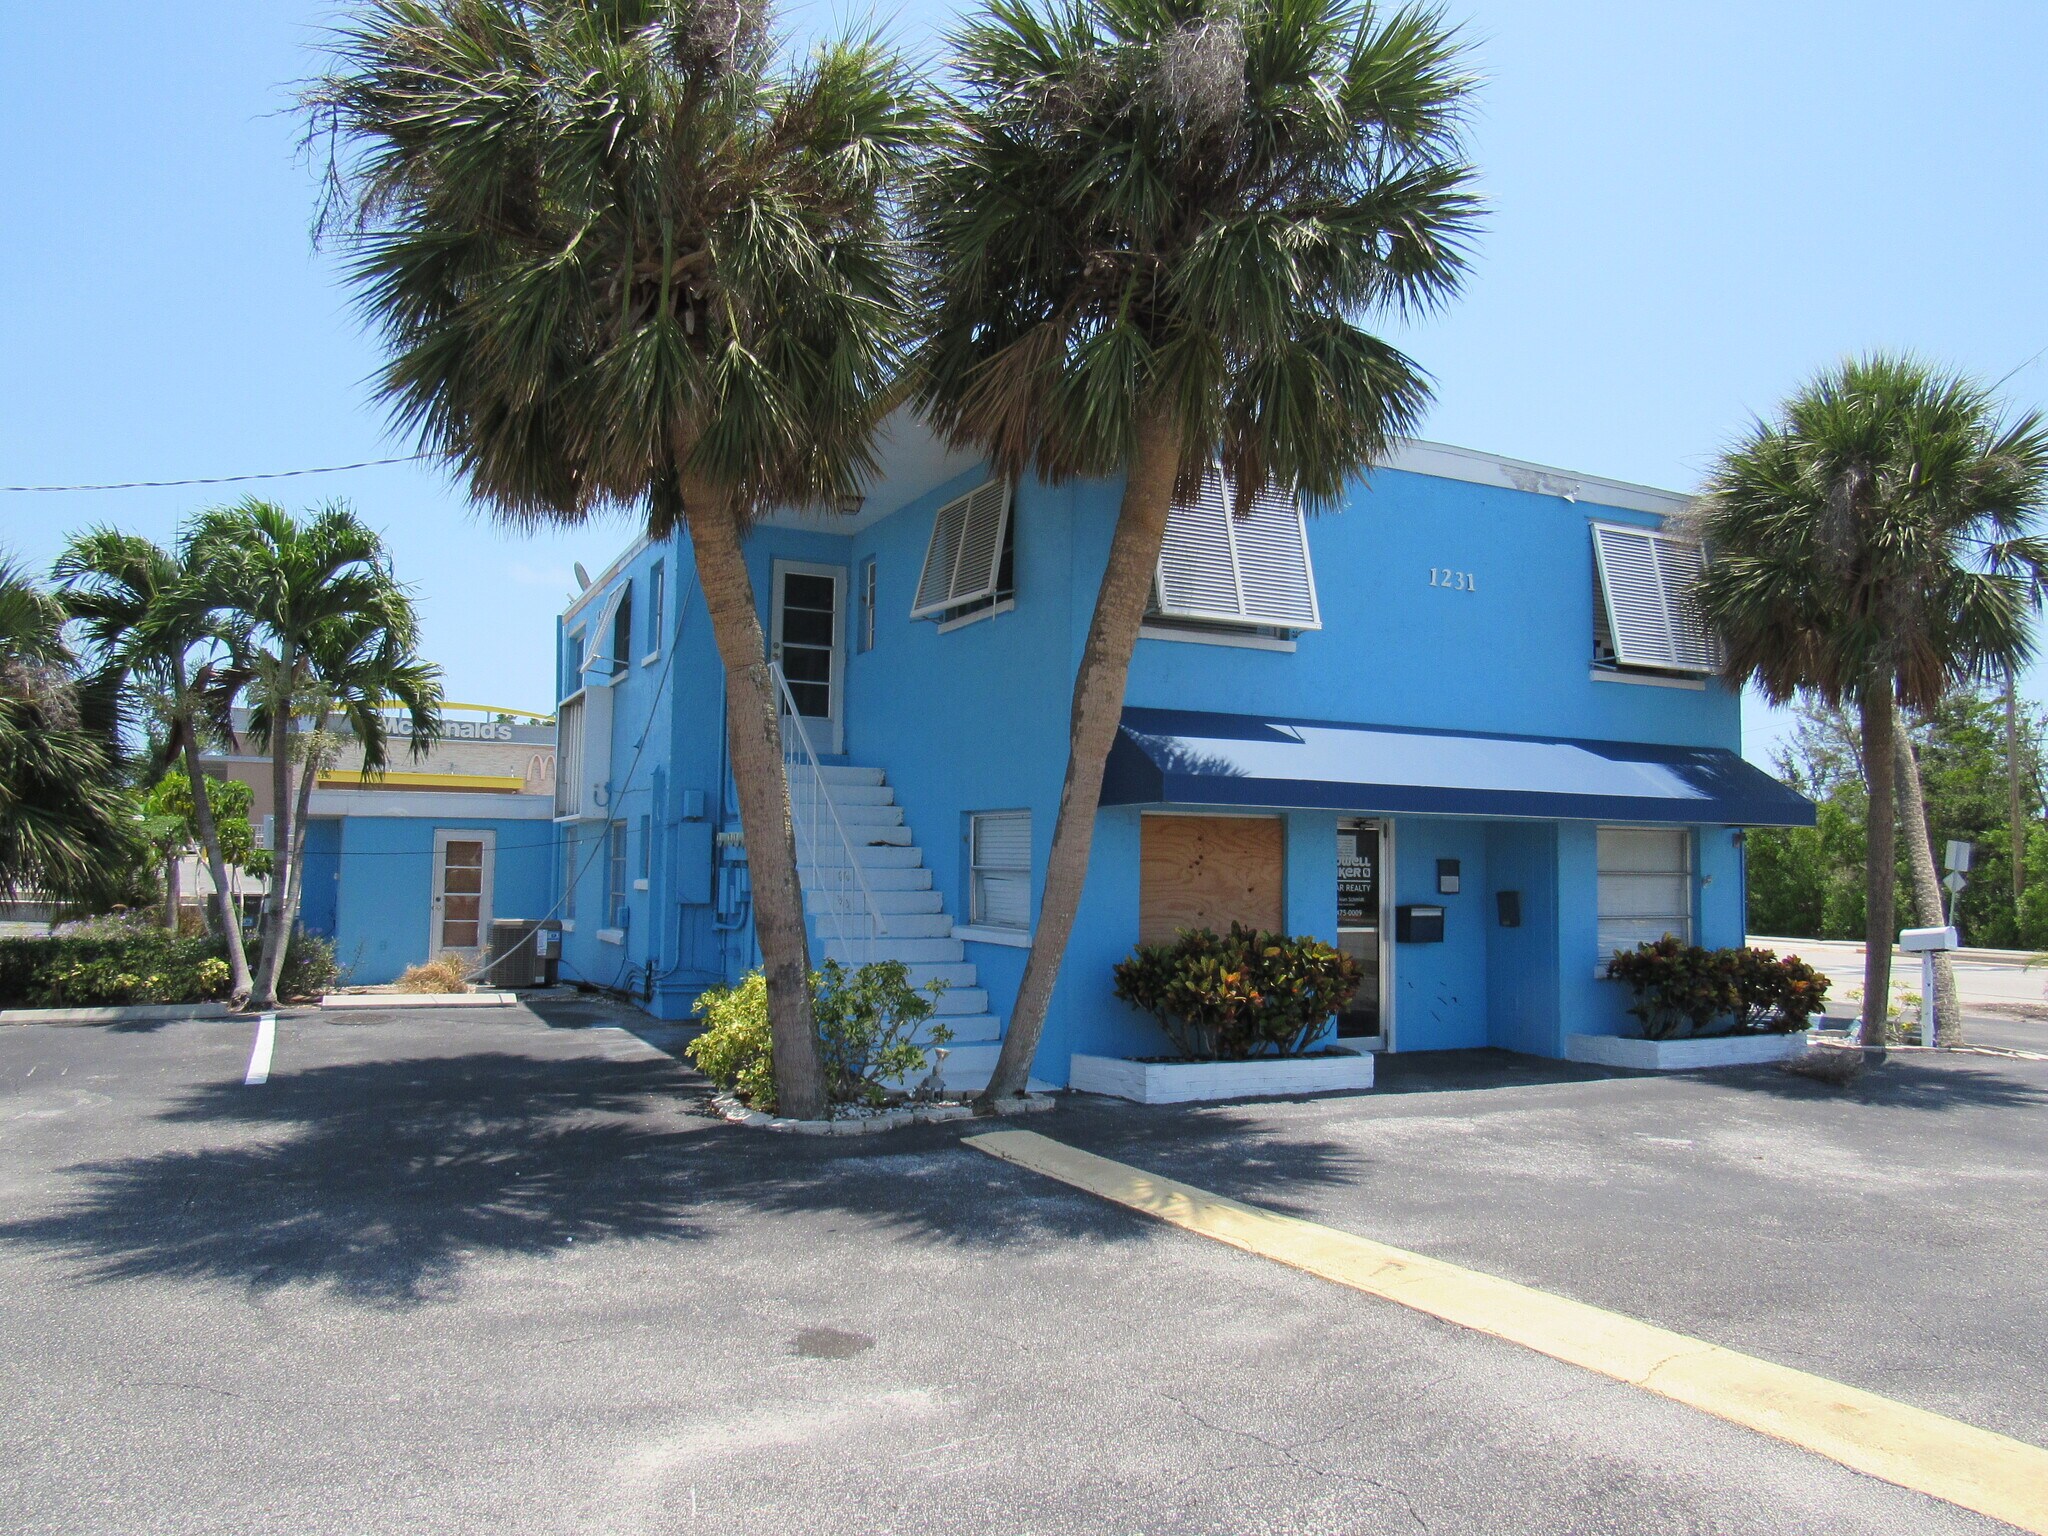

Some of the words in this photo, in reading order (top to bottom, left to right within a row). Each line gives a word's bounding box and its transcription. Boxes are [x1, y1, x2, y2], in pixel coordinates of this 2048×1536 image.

[1429, 567, 1476, 593] 1231
[384, 716, 512, 740] Mcnald's
[1345, 884, 1371, 892] REALTY
